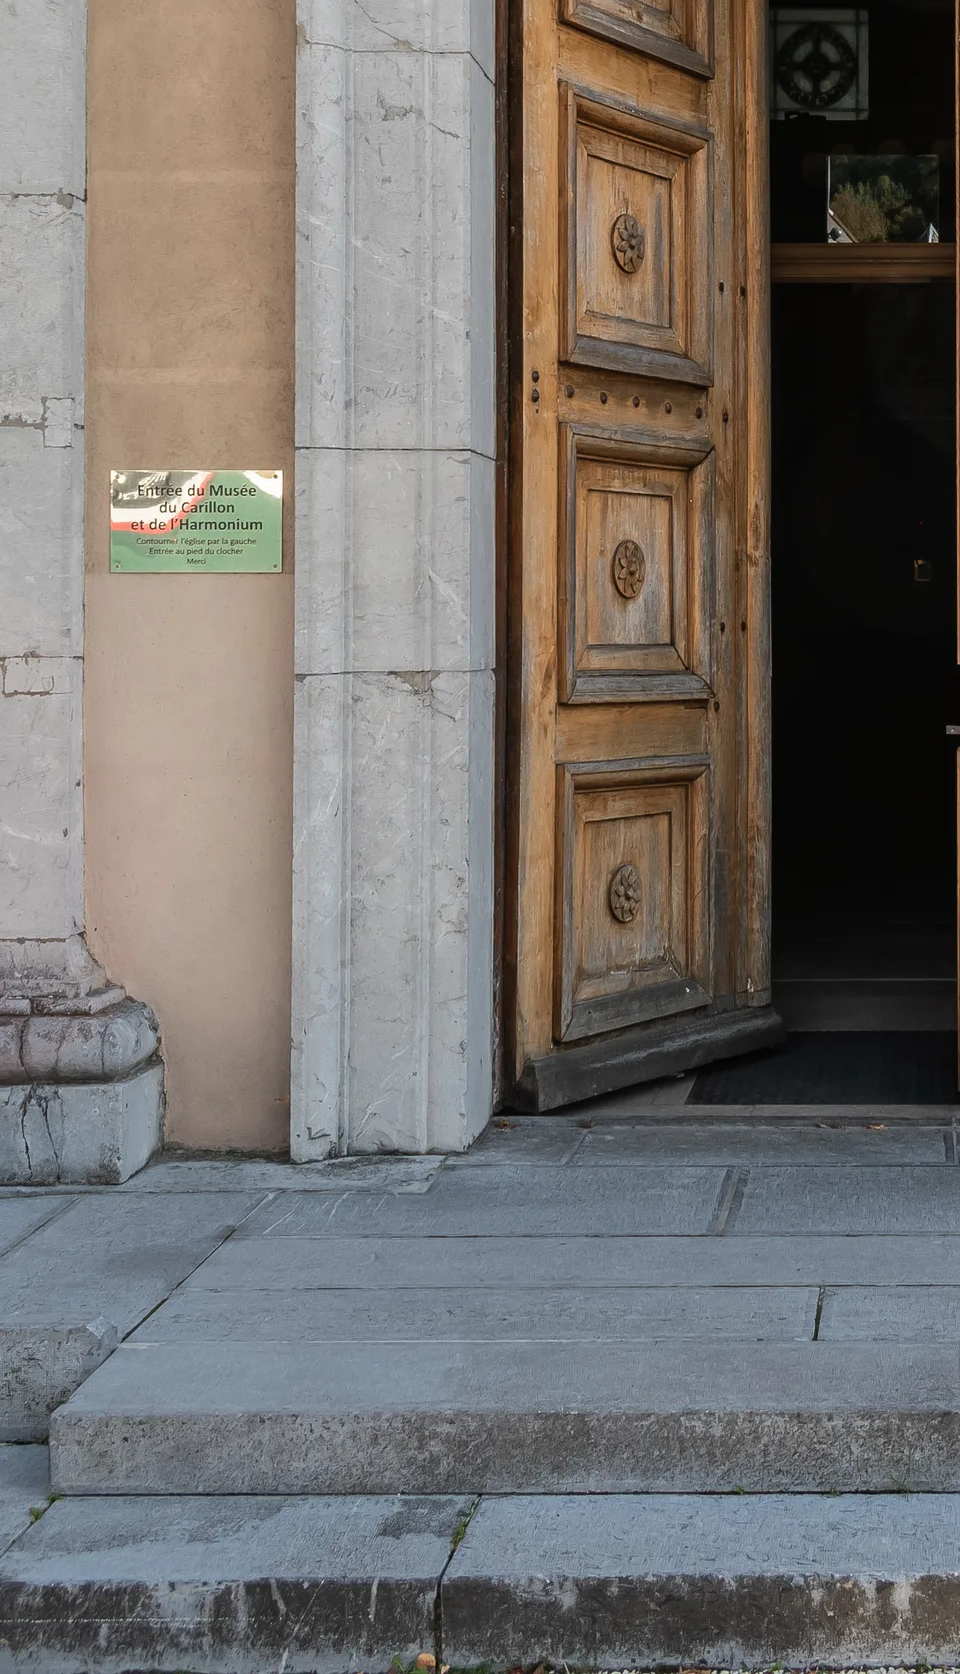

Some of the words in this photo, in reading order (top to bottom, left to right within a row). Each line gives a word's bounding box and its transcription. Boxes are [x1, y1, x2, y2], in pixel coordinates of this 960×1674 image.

[138, 484, 182, 496] Entrée
[187, 484, 205, 496] du
[209, 484, 256, 496] Musée
[160, 501, 176, 513] du
[182, 501, 235, 513] Carillon
[131, 520, 145, 530] et
[149, 518, 166, 530] de
[170, 518, 262, 530] l'Harmonium
[180, 538, 206, 546] l'église
[230, 538, 256, 546] gauche
[186, 548, 202, 556] pied
